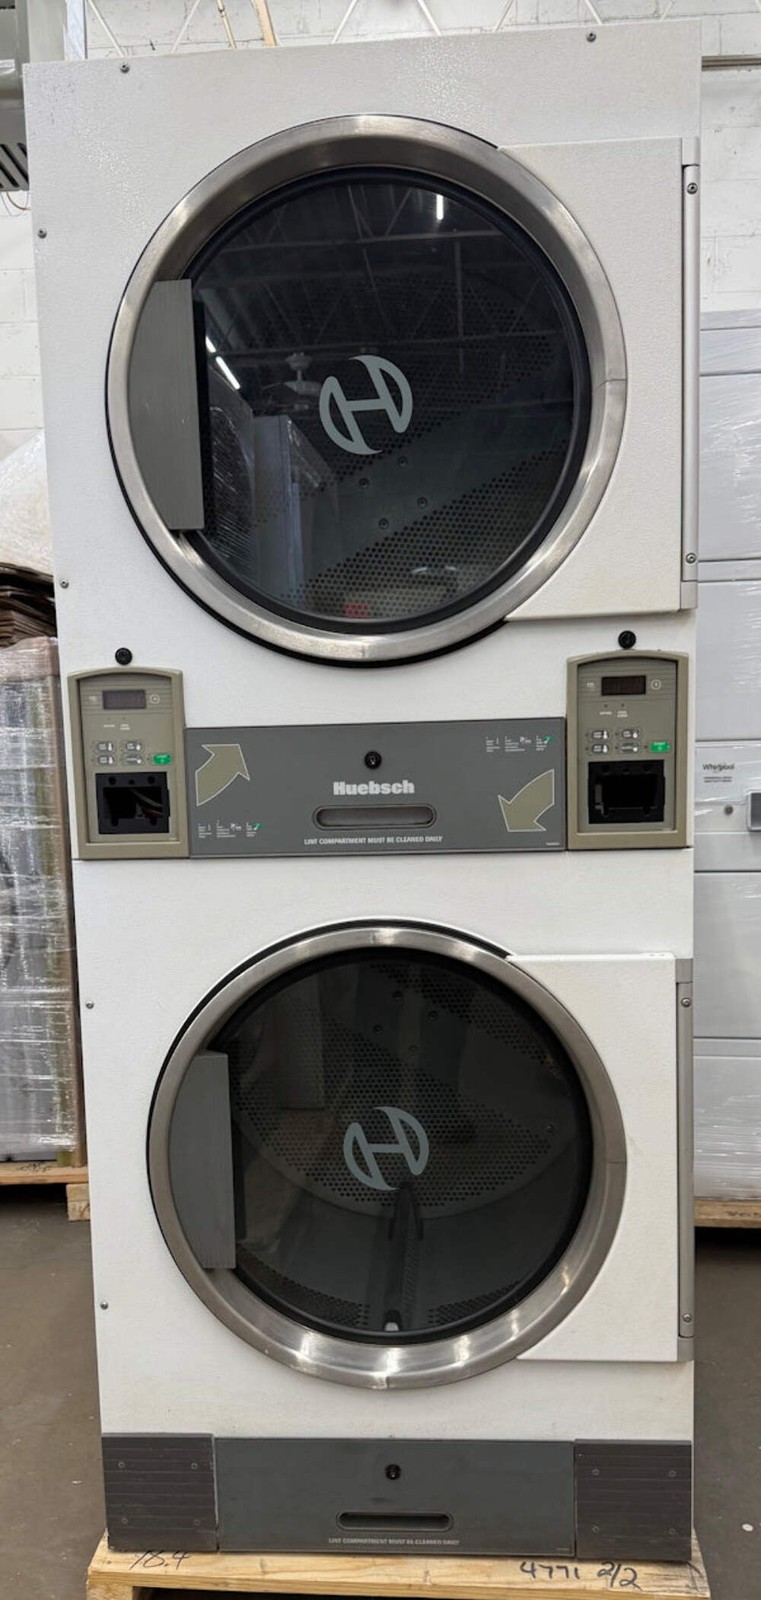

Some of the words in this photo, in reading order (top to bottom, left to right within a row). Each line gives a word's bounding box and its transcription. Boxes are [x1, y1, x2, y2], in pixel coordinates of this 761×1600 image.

[702, 763, 735, 772] Whirlpool
[333, 780, 415, 796] Huebsch
[318, 837, 366, 845] COMPARTMENT
[386, 836, 395, 844] BE
[424, 835, 443, 843] DAILY
[520, 1562, 580, 1579] 4771
[597, 1562, 643, 1591] 2/2
